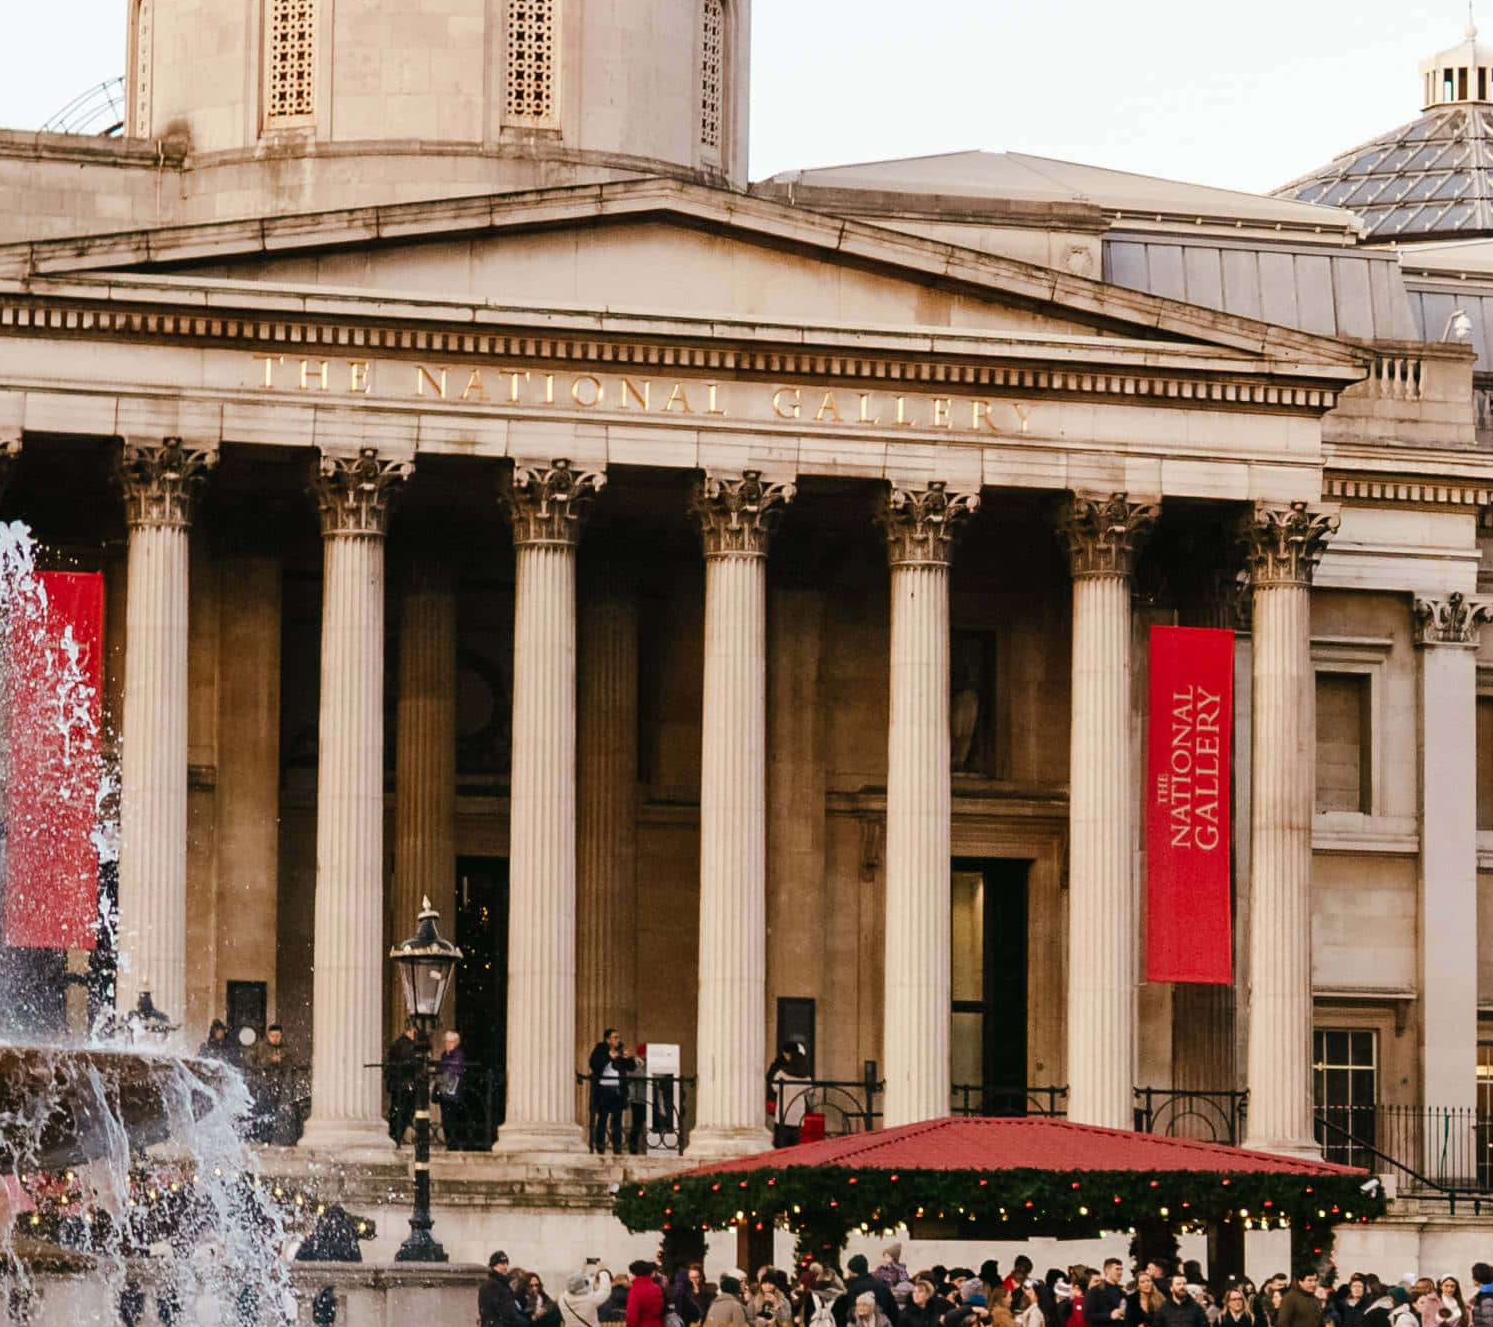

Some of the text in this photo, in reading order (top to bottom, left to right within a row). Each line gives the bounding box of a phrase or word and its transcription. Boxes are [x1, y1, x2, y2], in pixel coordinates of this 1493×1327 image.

[252, 354, 1037, 434] THE NATIONAL GALLERY
[1158, 771, 1169, 805] THE
[1170, 684, 1194, 849] NATIONAL
[1194, 686, 1220, 850] GALLERY
